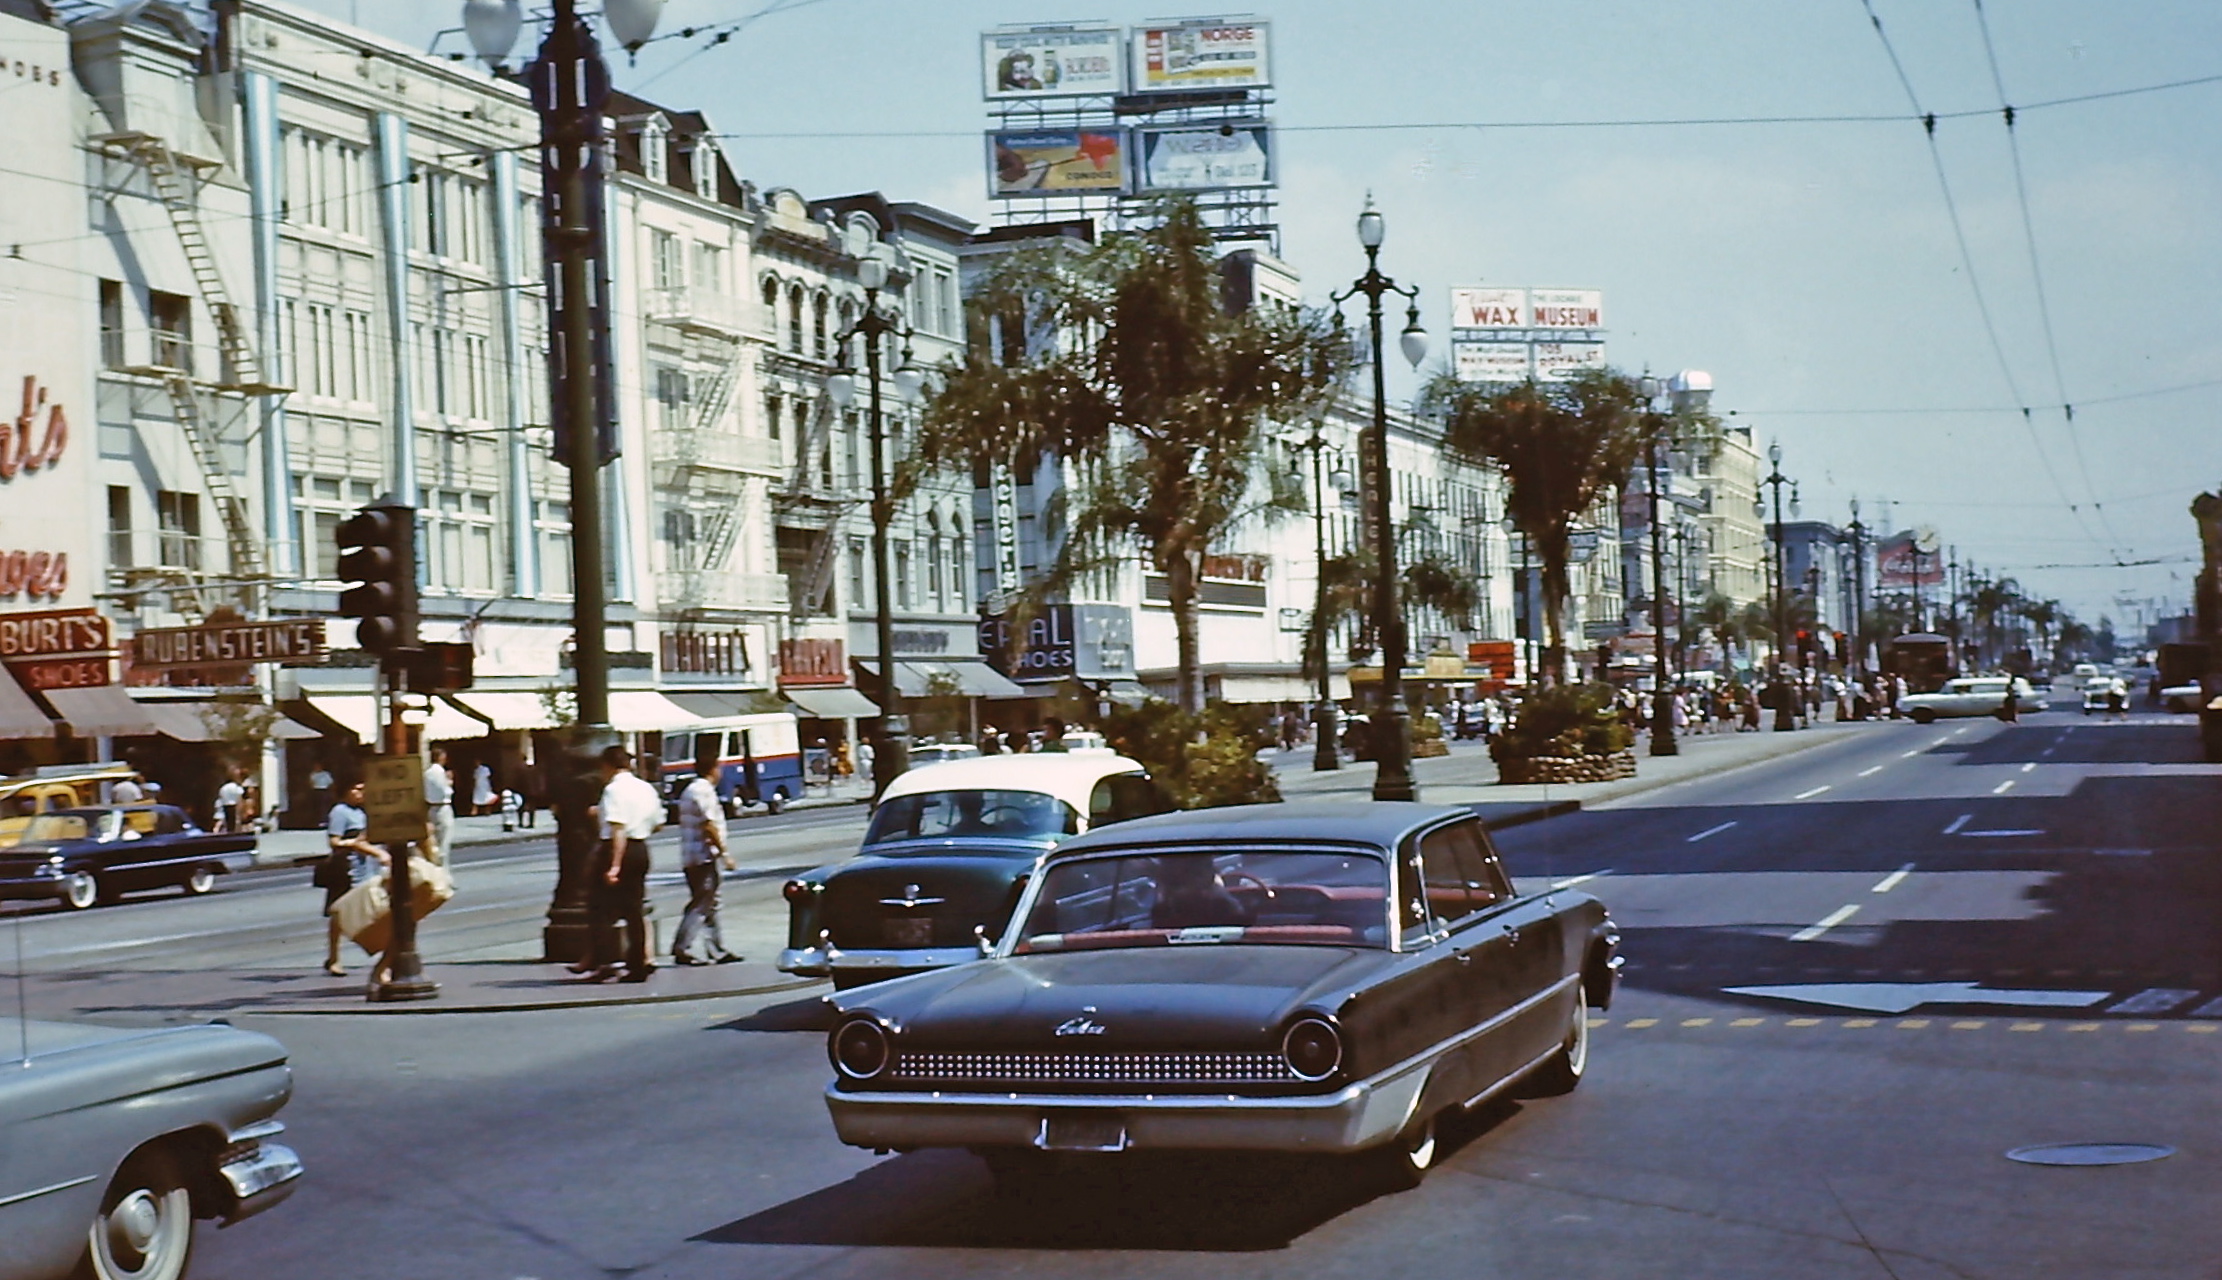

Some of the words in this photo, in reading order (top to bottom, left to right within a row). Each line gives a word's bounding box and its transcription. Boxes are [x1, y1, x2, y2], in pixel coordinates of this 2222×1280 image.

[1201, 27, 1255, 41] NORGE
[1472, 307, 1518, 325] WAX
[1535, 308, 1598, 326] MUSEUM
[1539, 353, 1583, 367] ROYAL
[0, 615, 103, 655] BURT'S
[143, 624, 312, 663] RUBENSTEIN'S
[30, 662, 104, 688] SHOES
